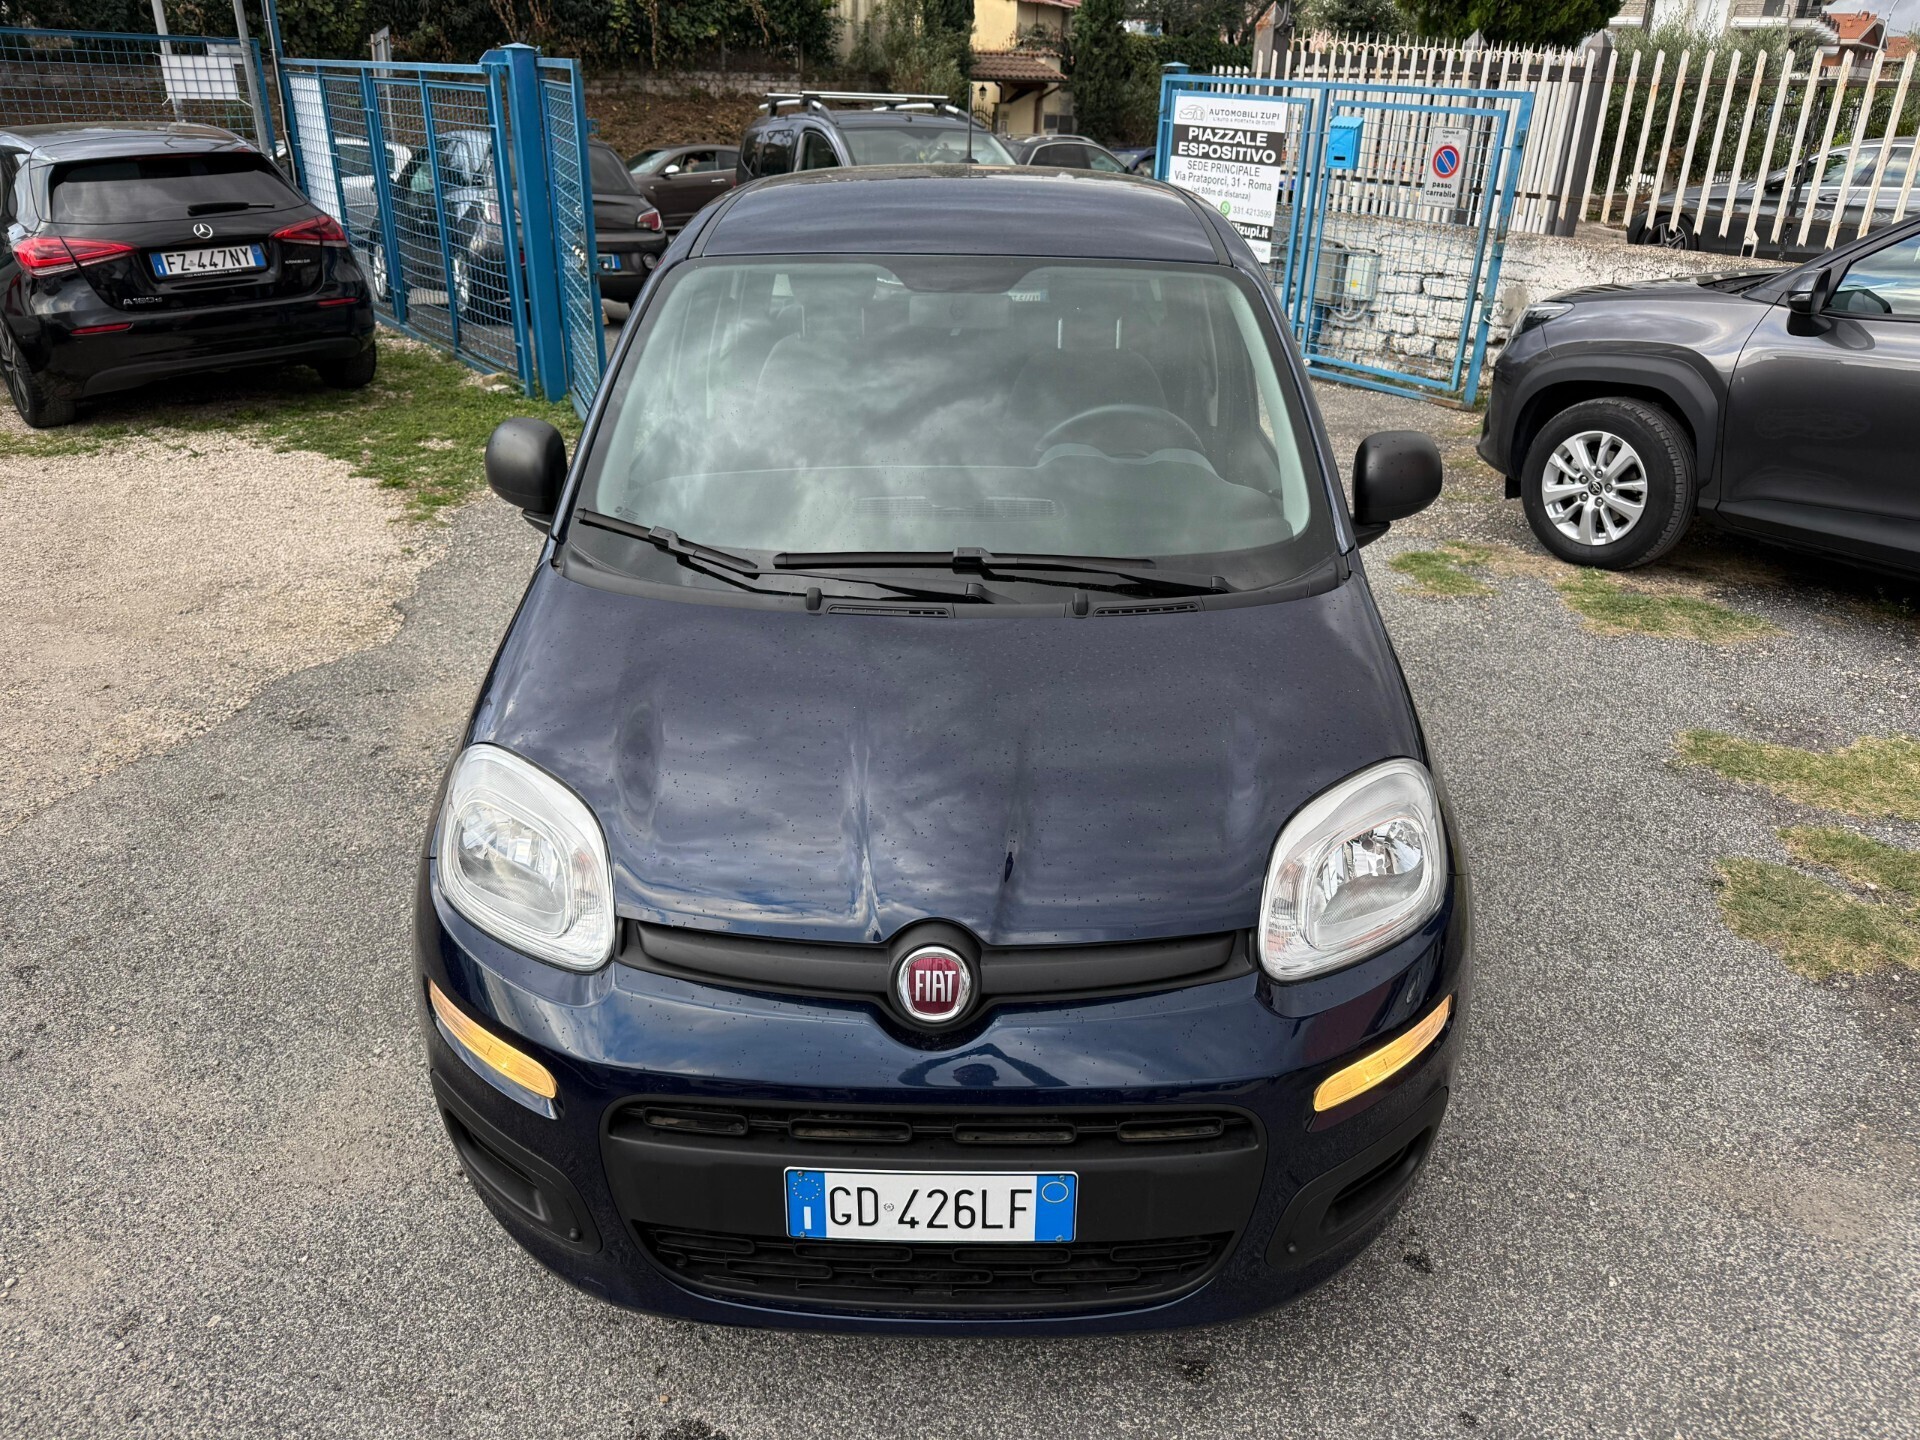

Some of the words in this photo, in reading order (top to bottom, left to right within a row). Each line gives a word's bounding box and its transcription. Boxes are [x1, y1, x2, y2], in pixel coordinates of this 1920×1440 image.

[1209, 108, 1258, 119] AUTOMOBILI
[1260, 111, 1280, 121] ZUPI
[1188, 126, 1268, 147] PIAZZALE
[1177, 141, 1277, 164] ESPOSITIVO
[1187, 160, 1209, 172] SEDE
[1210, 161, 1261, 177] PRINCIPALE
[1174, 170, 1186, 181] Via
[1187, 172, 1229, 187] Prataporci,
[1230, 177, 1240, 187] 31
[1247, 179, 1272, 191] Roma
[1431, 181, 1452, 189] passo
[1217, 188, 1223, 197] di
[1224, 189, 1251, 202] distanza)
[1425, 190, 1456, 199] carrabile
[164, 253, 191, 273] FZ
[197, 247, 251, 269] 447NY
[915, 969, 957, 1002] FIAT
[829, 1186, 879, 1226] GD
[897, 1188, 1032, 1229] 426LF
